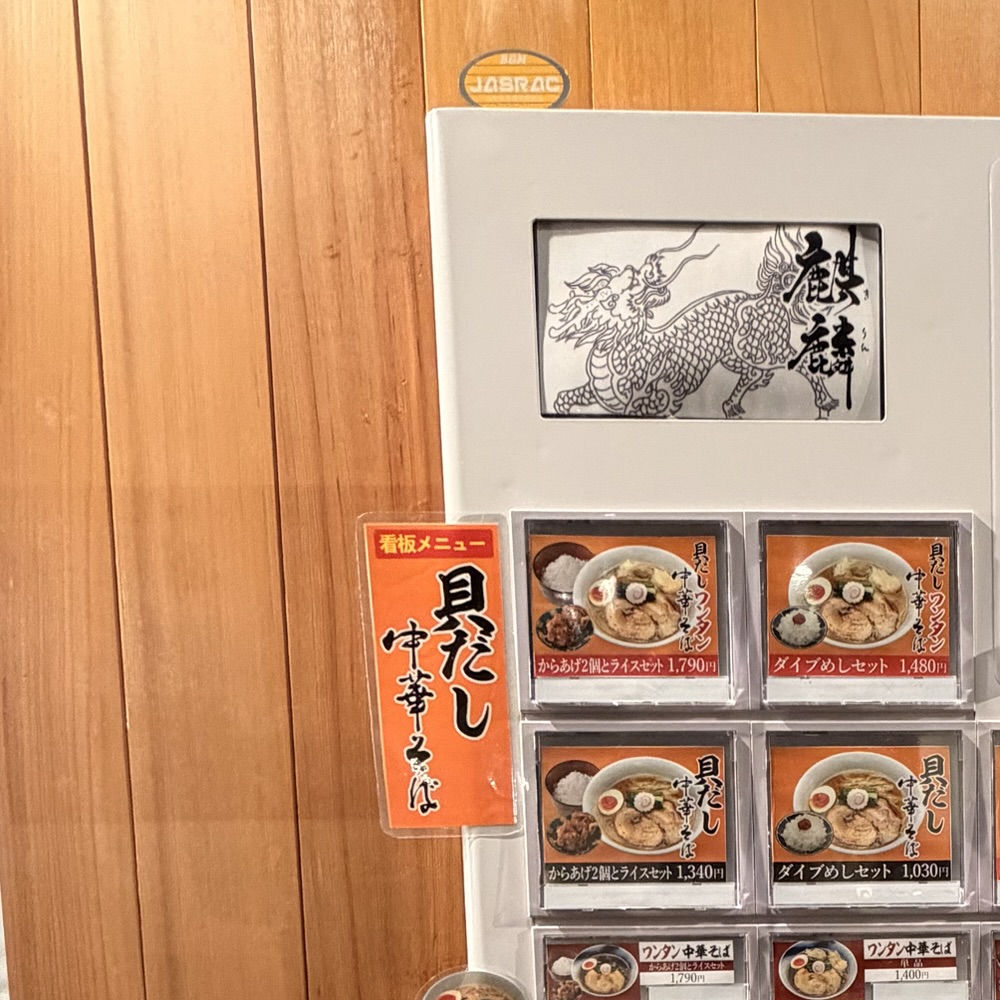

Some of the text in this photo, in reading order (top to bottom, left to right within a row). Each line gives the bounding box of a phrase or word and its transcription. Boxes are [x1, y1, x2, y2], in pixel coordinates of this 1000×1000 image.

[470, 75, 560, 93] JASRAC
[379, 534, 486, 555] 看板メニュー
[672, 567, 694, 653] 中華そば
[906, 569, 927, 655] 中華そば
[432, 564, 498, 739] 貝だし
[538, 657, 716, 674] からあげ2個とライスセット 1,790円
[773, 657, 947, 674] ダイブめしセット 1,480円
[380, 620, 439, 816] 中華そば
[694, 754, 724, 836] 貝だし
[919, 753, 949, 835] 貝だし
[672, 775, 695, 859] 中華そば
[897, 775, 919, 858] 中華そば
[548, 864, 724, 881] からあげ2個とライスセット 1,340円
[777, 862, 949, 880] ダイブめしセット 1,030円
[642, 943, 731, 960] ワンタン中華そば
[867, 940, 953, 958] ワンタン中華そば
[670, 972, 706, 984] 1,790円
[895, 968, 930, 980] 1,400円
